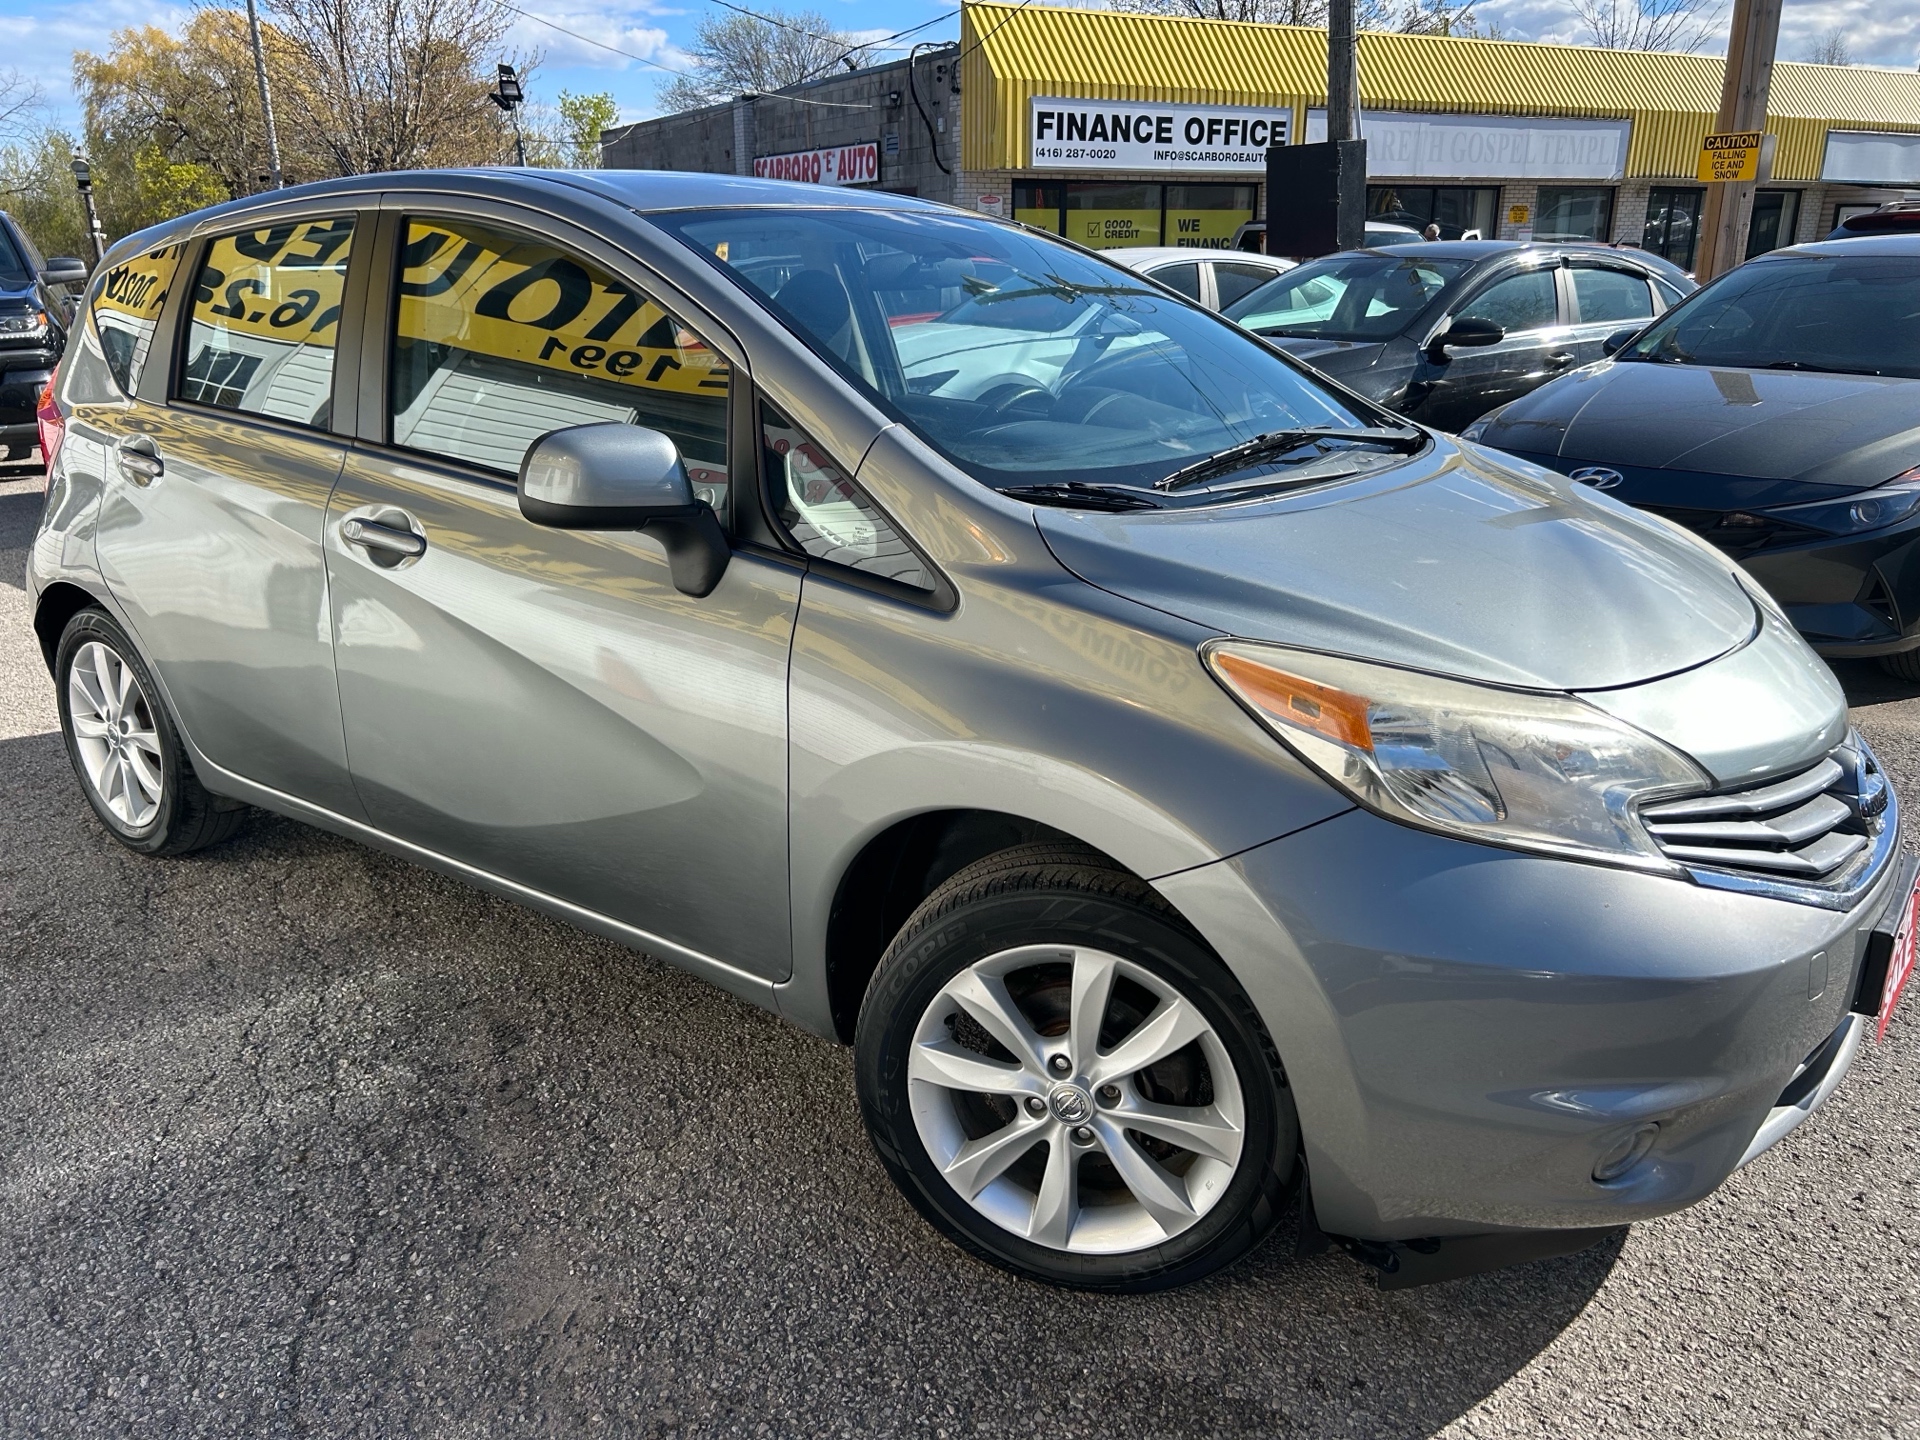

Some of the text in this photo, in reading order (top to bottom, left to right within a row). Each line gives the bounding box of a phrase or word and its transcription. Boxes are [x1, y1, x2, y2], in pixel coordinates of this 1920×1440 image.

[1036, 111, 1287, 147] FINANCE OFFICE
[1706, 135, 1758, 149] CAUTION
[1035, 148, 1116, 160] (416) 287-0020
[1712, 150, 1747, 160] FALLING
[837, 145, 876, 181] AUTO
[1711, 160, 1744, 170] ICE AND
[1713, 170, 1740, 179] SNOW
[1104, 219, 1132, 230] GOOD
[1177, 219, 1201, 232] WE
[1104, 229, 1140, 239] CREDIT
